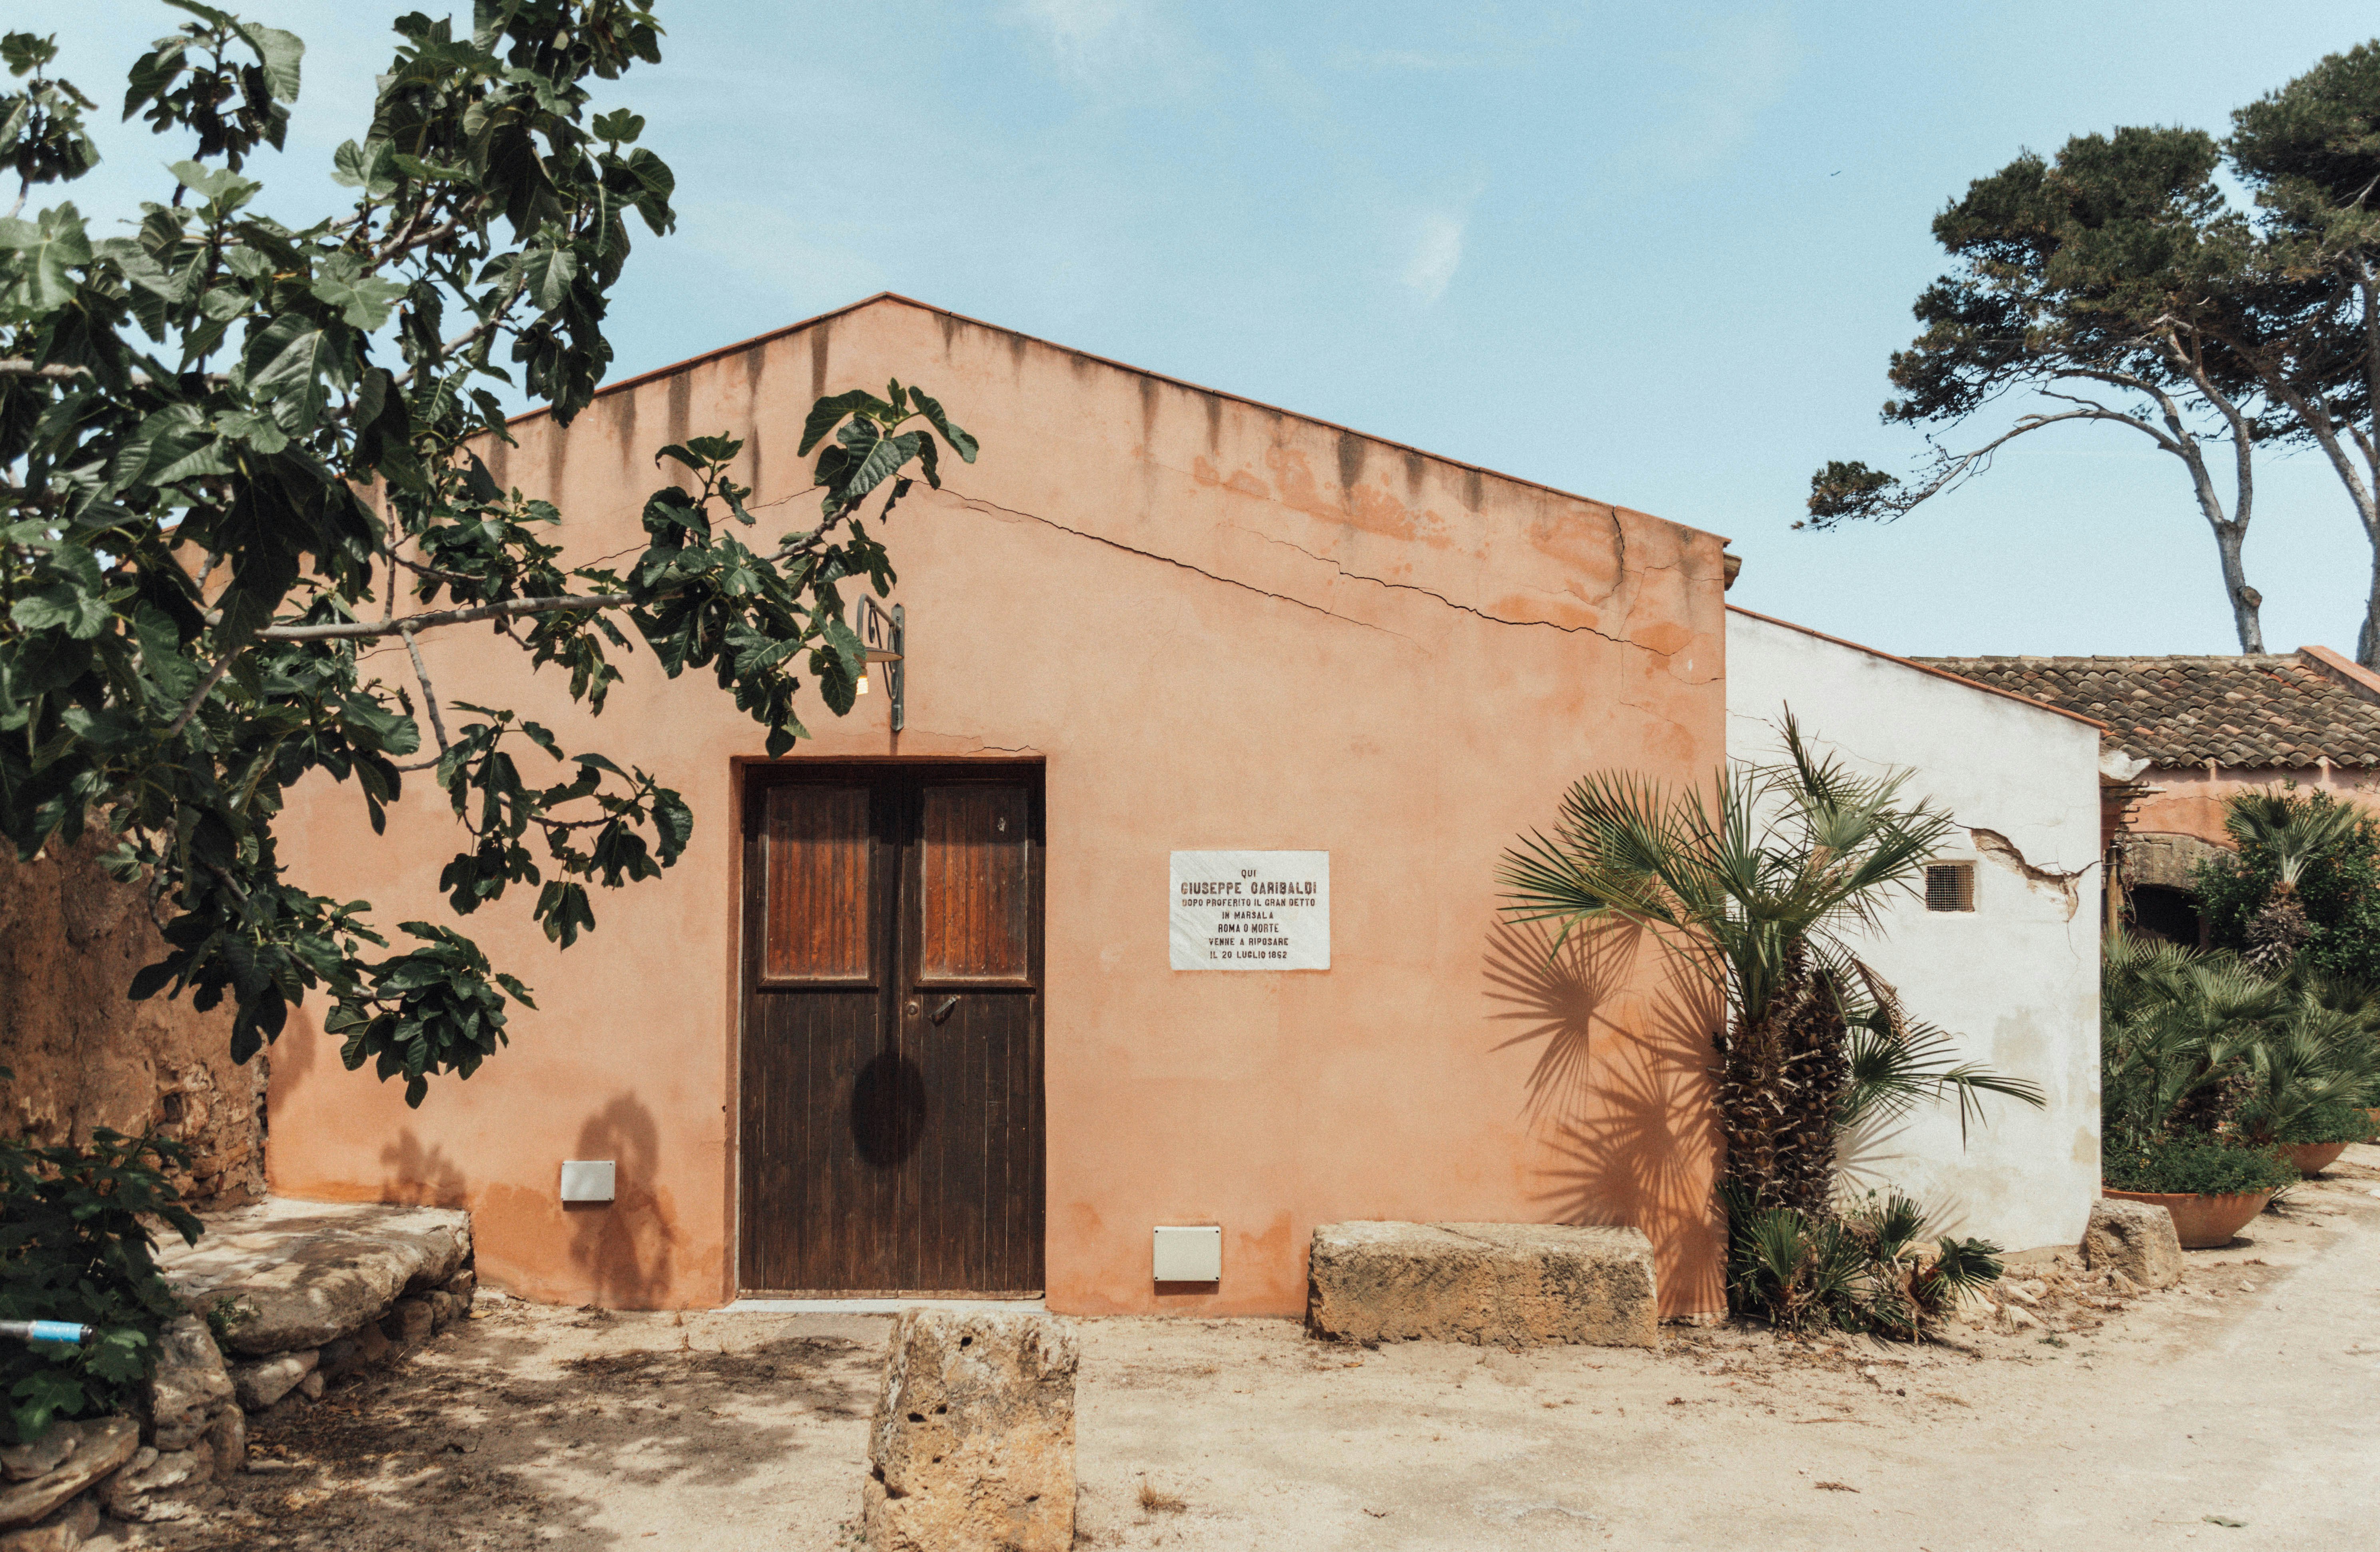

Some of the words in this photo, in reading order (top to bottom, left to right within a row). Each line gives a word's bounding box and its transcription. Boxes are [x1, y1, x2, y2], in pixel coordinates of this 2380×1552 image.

[1241, 870, 1257, 878] QUI
[1181, 882, 1242, 894] GIUSEPPE
[1251, 882, 1317, 895] GARIBALDI
[1218, 924, 1240, 933] ROMA
[1244, 924, 1248, 932] O
[1252, 924, 1279, 933] MORTE
